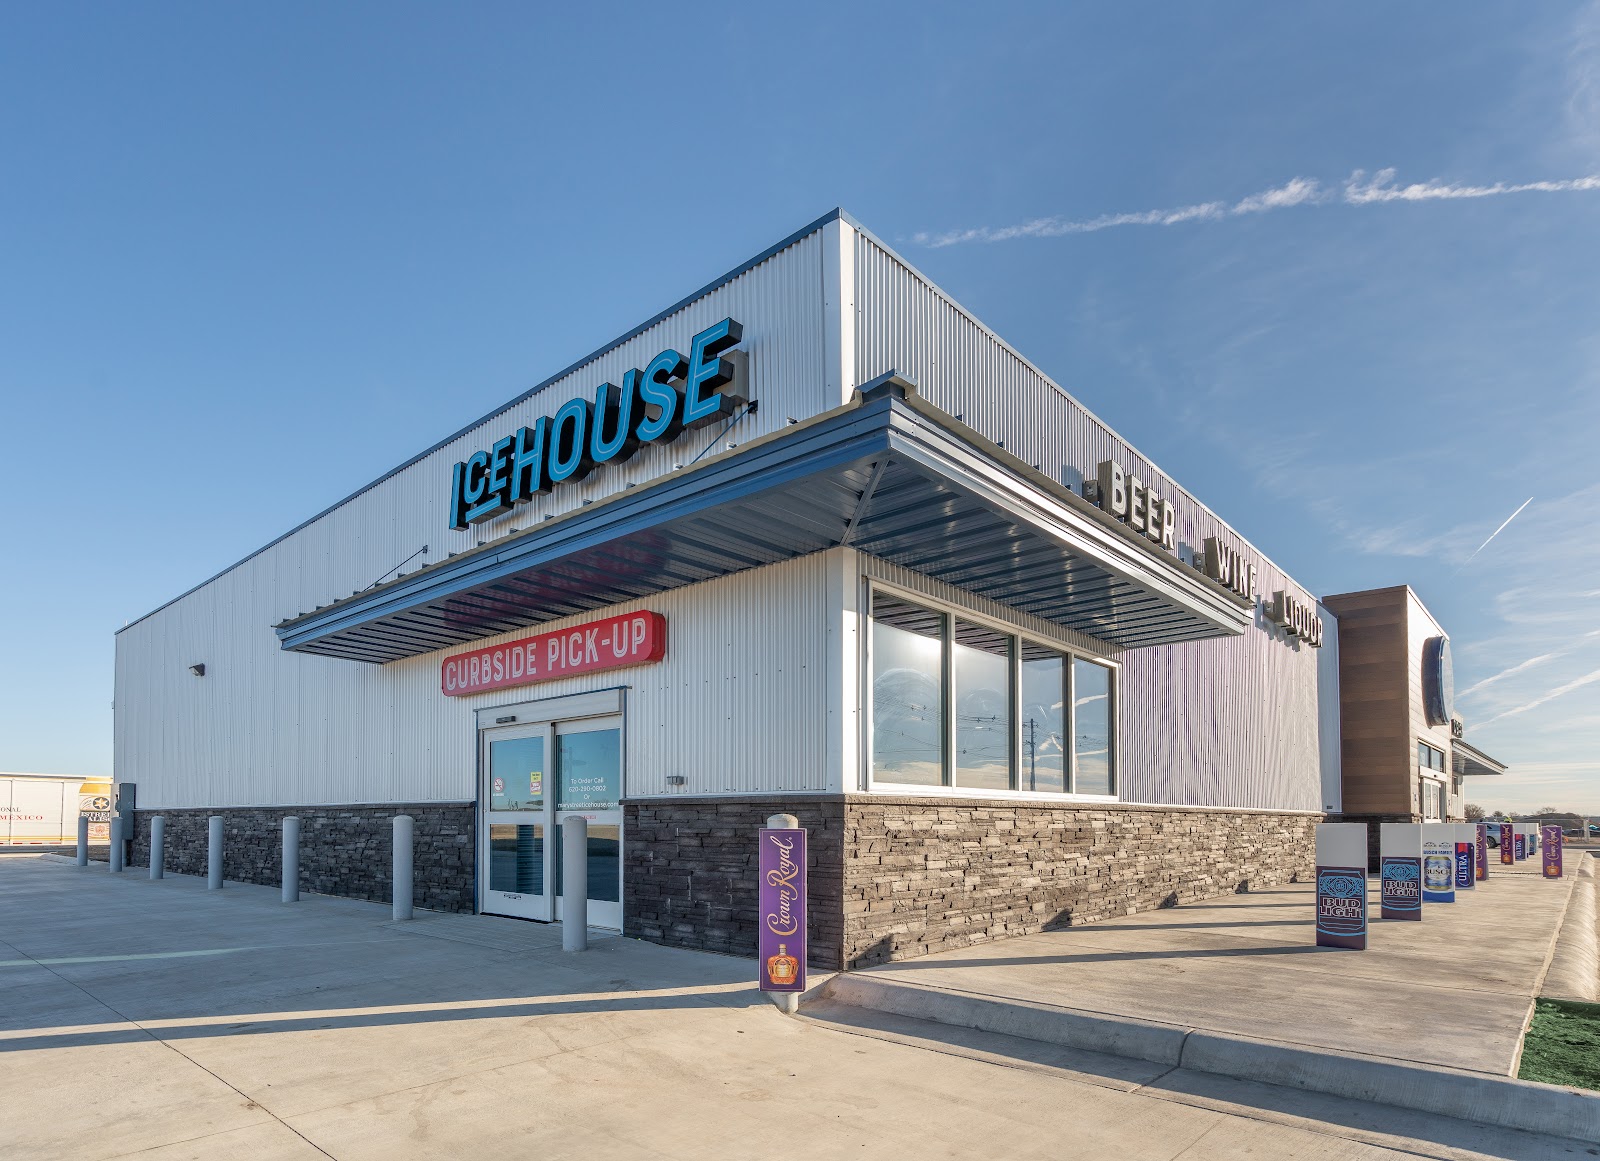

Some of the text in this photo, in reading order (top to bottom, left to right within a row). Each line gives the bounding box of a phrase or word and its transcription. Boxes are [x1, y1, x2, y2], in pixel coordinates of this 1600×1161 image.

[449, 317, 731, 530] ICEHOUSE
[1111, 460, 1175, 550] BEER
[1214, 536, 1257, 603] WINE
[1283, 590, 1323, 648] LIQUOR
[446, 617, 646, 691] CURBSIDE PICK-UP
[593, 776, 604, 784] Call
[766, 835, 799, 936] Crown Royal
[1385, 880, 1417, 890] BUD
[1458, 854, 1468, 881] ULTRA
[1322, 897, 1361, 909] BUD
